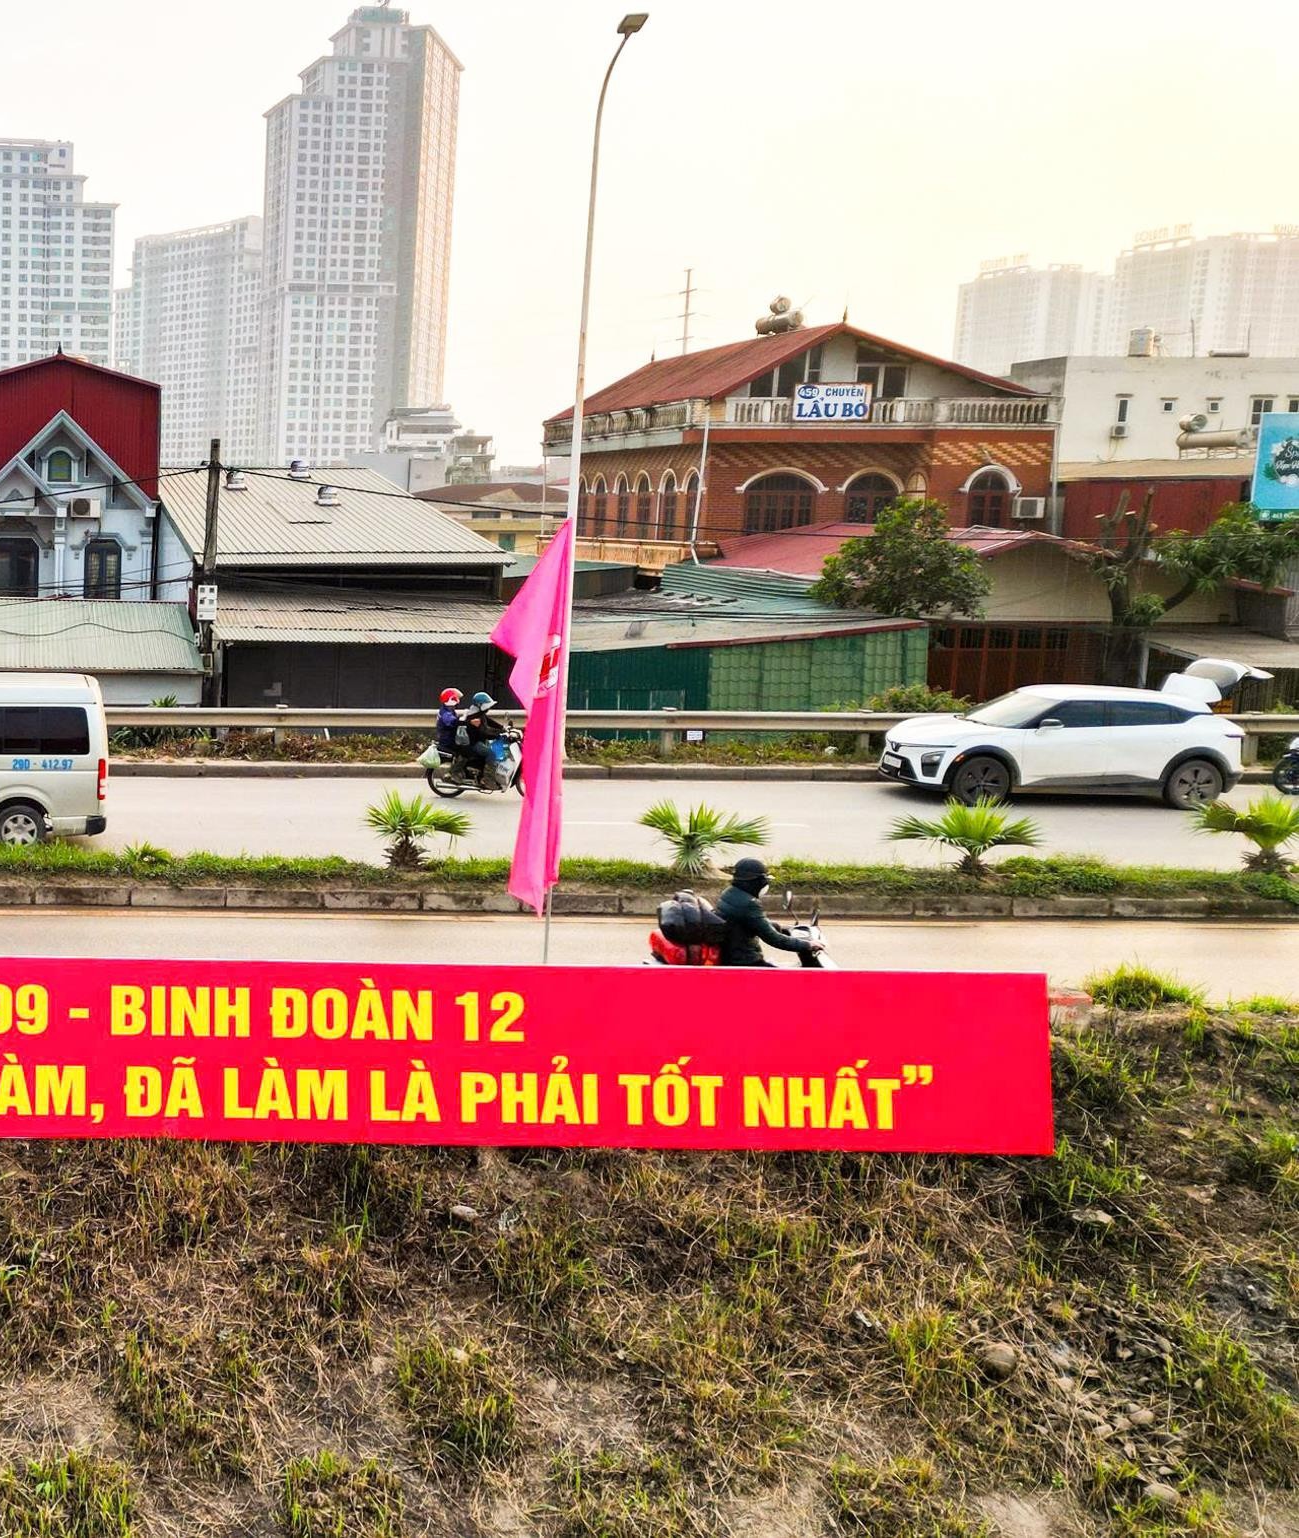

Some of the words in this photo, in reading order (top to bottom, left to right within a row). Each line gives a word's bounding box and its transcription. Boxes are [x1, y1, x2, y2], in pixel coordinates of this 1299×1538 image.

[796, 397, 838, 418] LẨU
[841, 399, 868, 418] BÒ
[799, 388, 818, 397] 459
[825, 385, 864, 397] CHUYÊN
[69, 1007, 89, 1018] -
[111, 985, 250, 1037] BINH
[269, 978, 433, 1041] ĐOÀN
[455, 992, 525, 1042] 12
[124, 1056, 204, 1118] ĐÃ
[223, 1057, 349, 1120] LÀM
[370, 1060, 442, 1122] LÀ
[460, 1055, 599, 1125] PHẢI
[618, 1056, 724, 1126] TỐT
